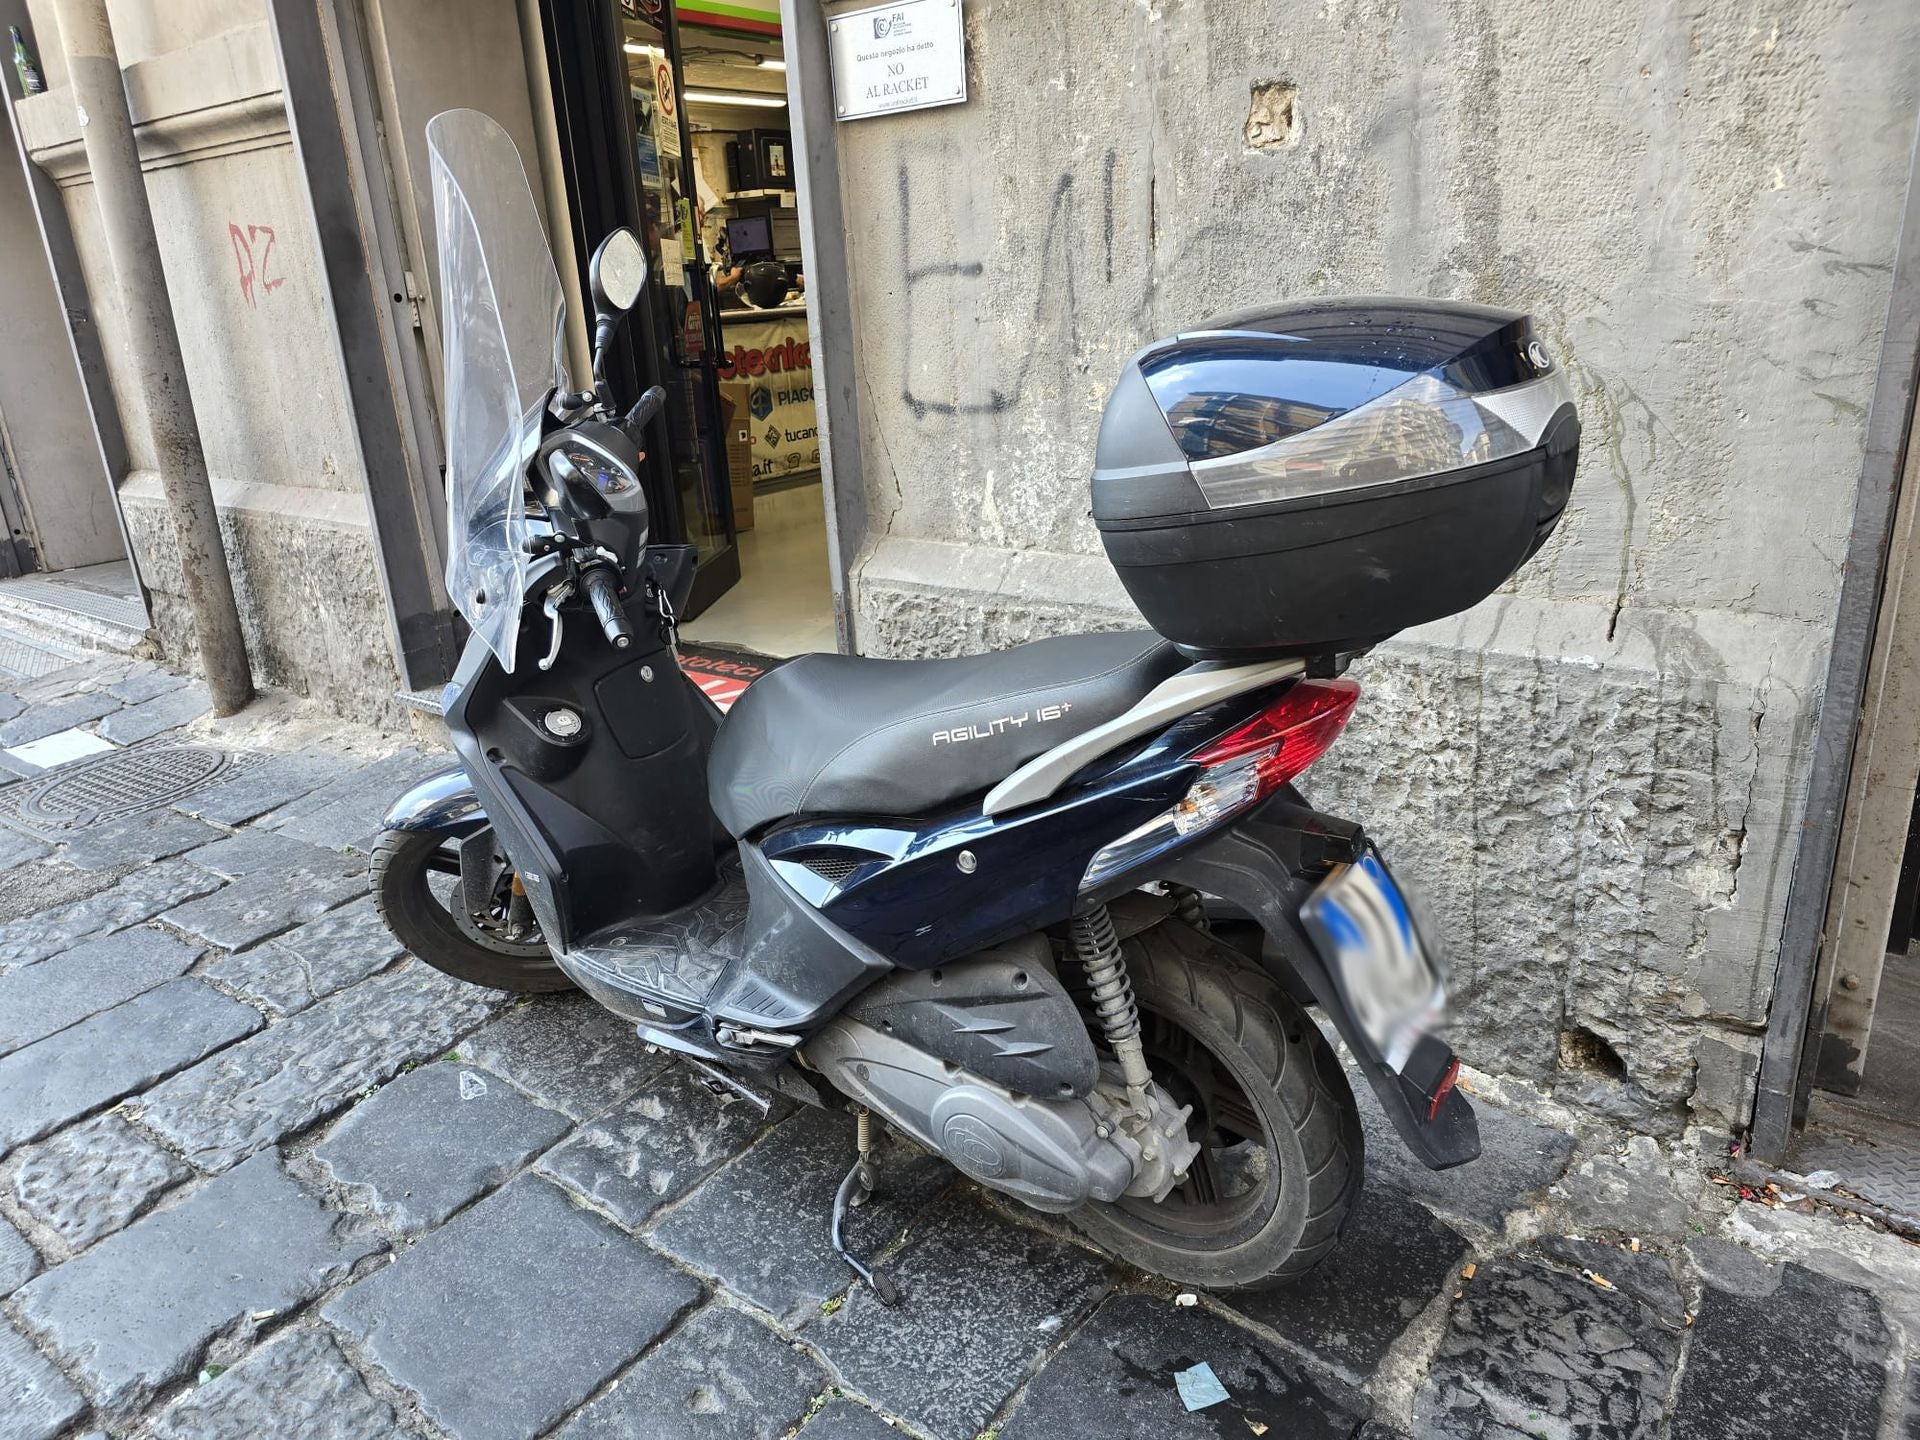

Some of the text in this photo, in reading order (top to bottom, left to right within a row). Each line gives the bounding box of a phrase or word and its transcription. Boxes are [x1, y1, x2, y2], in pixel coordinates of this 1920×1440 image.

[892, 12, 904, 22] FAI
[887, 63, 904, 76] NO
[866, 77, 929, 99] AL RACKET
[932, 712, 1029, 746] AGILITY
